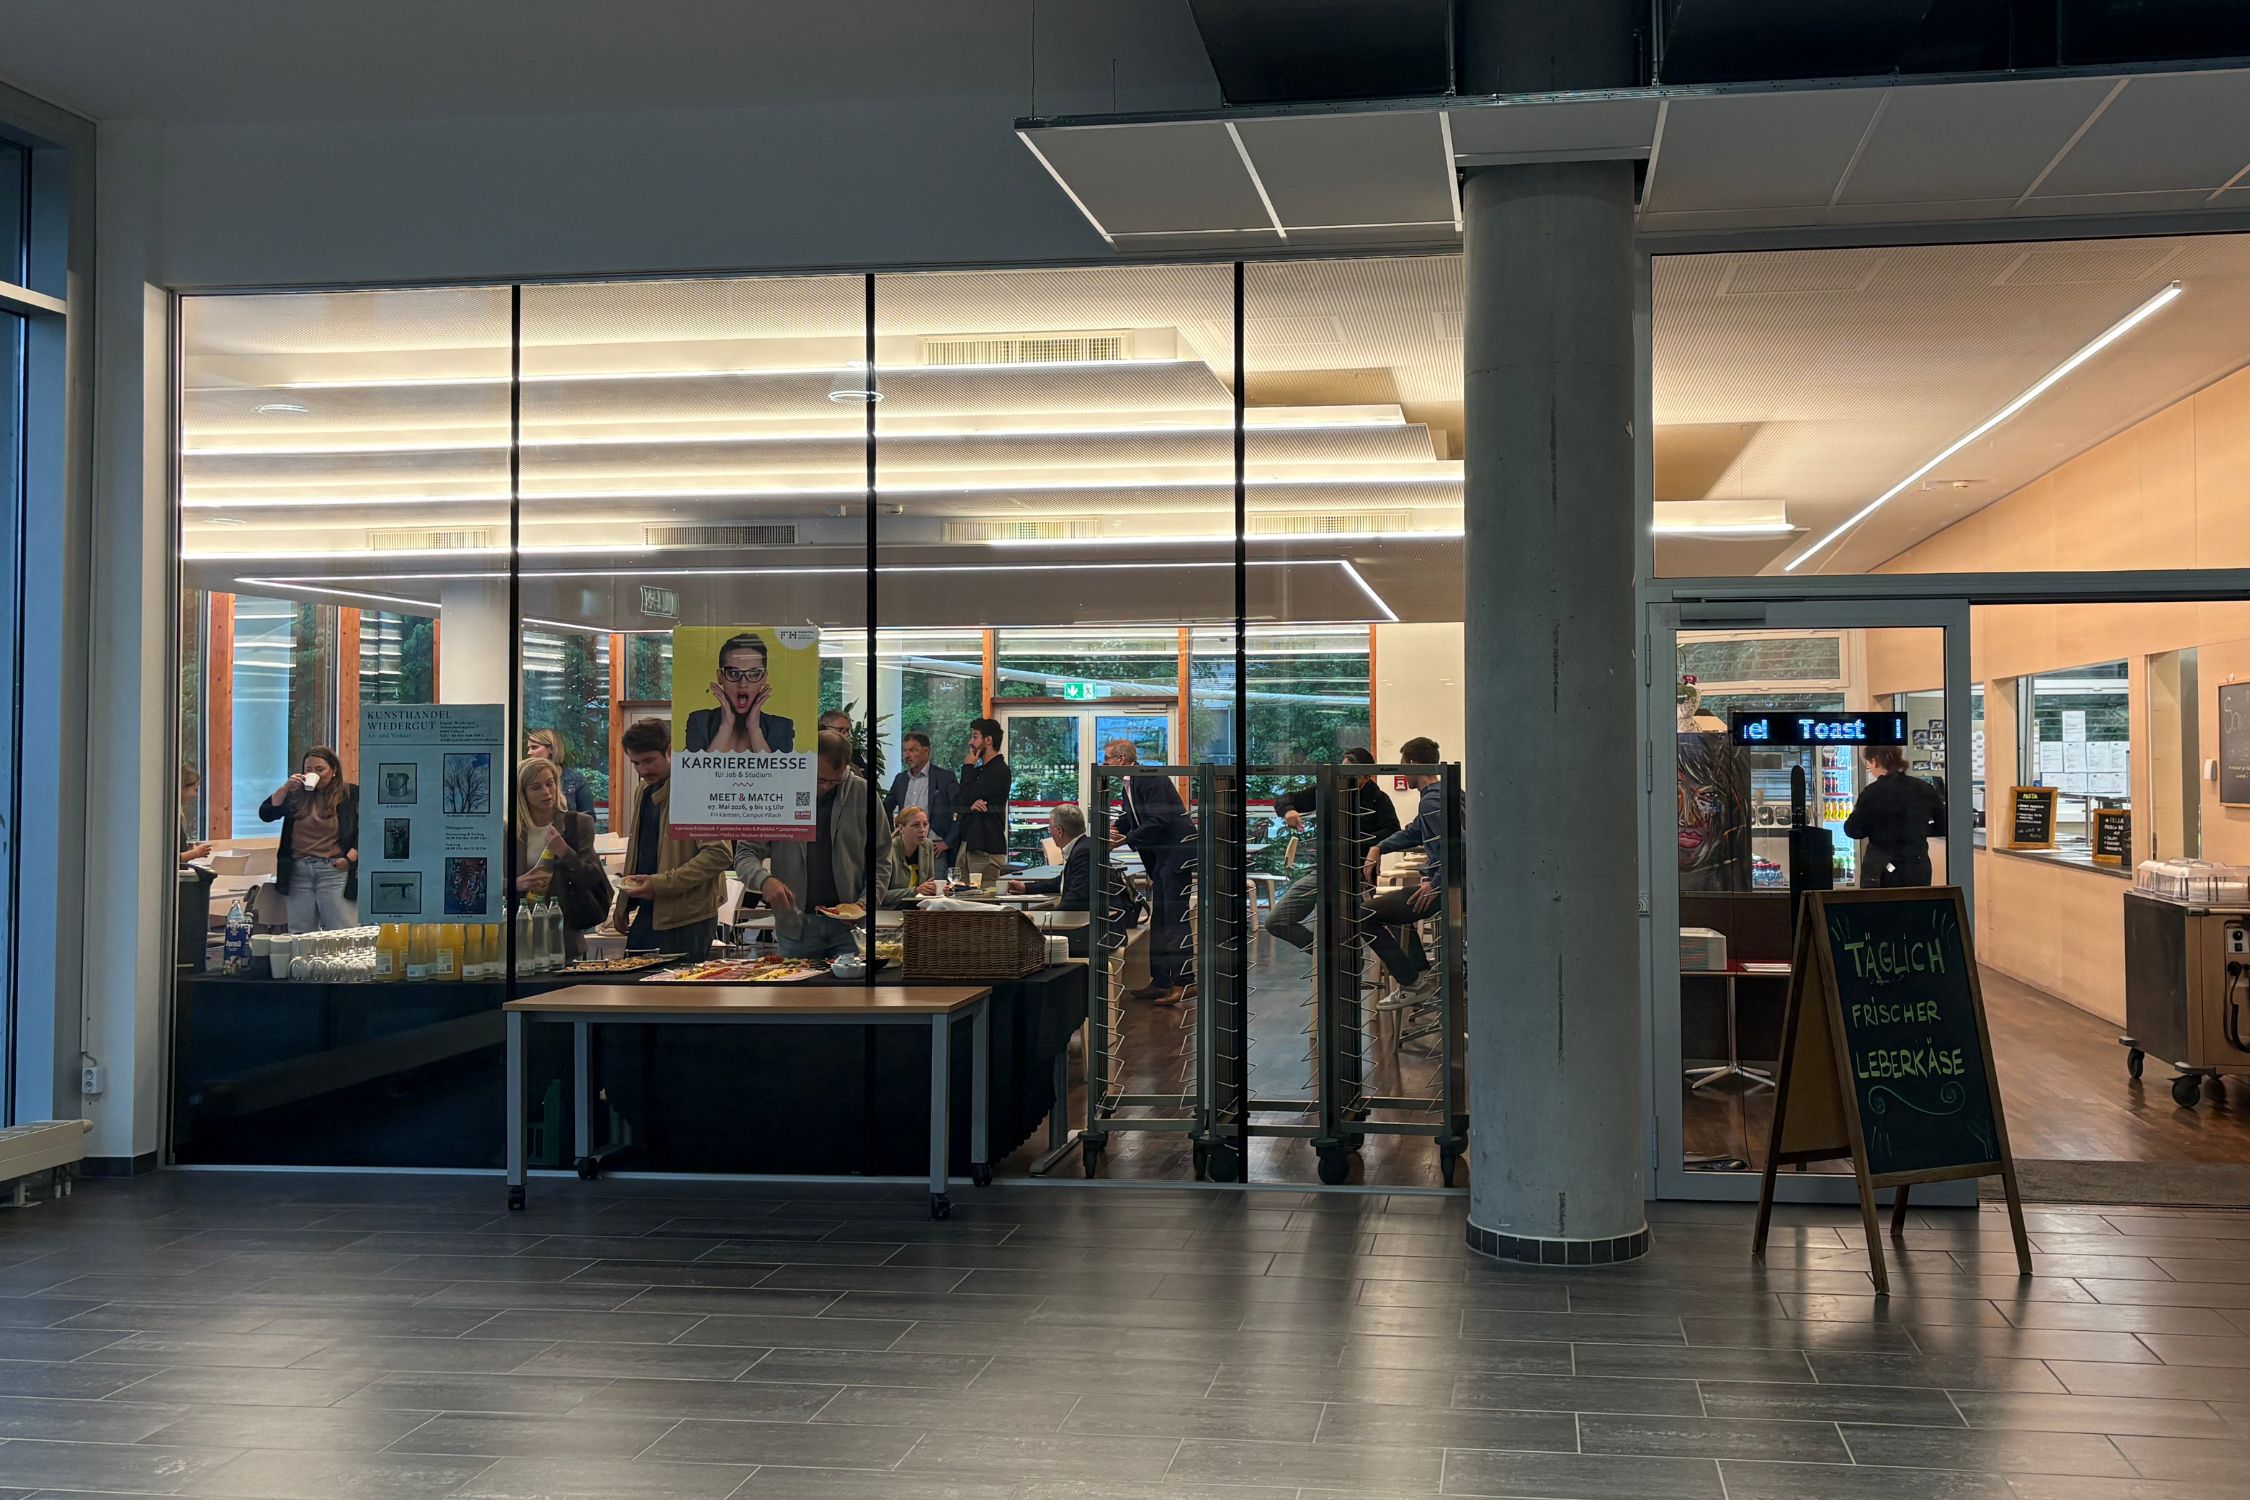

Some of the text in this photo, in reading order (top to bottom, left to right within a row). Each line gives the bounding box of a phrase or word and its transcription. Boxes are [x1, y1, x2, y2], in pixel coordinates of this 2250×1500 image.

[780, 630, 797, 639] FH
[367, 710, 452, 720] KUNSTHANDEL
[367, 721, 435, 731] WIEDERGUT
[1743, 718, 1867, 740] el Toast
[681, 757, 807, 770] KARRIEREMESSE
[709, 793, 783, 802] MEET & MATCH
[731, 803, 748, 812] 2026,
[764, 804, 772, 812] 15
[742, 812, 764, 820] Campus
[1855, 1036, 1966, 1079] LEBERKÄSE
